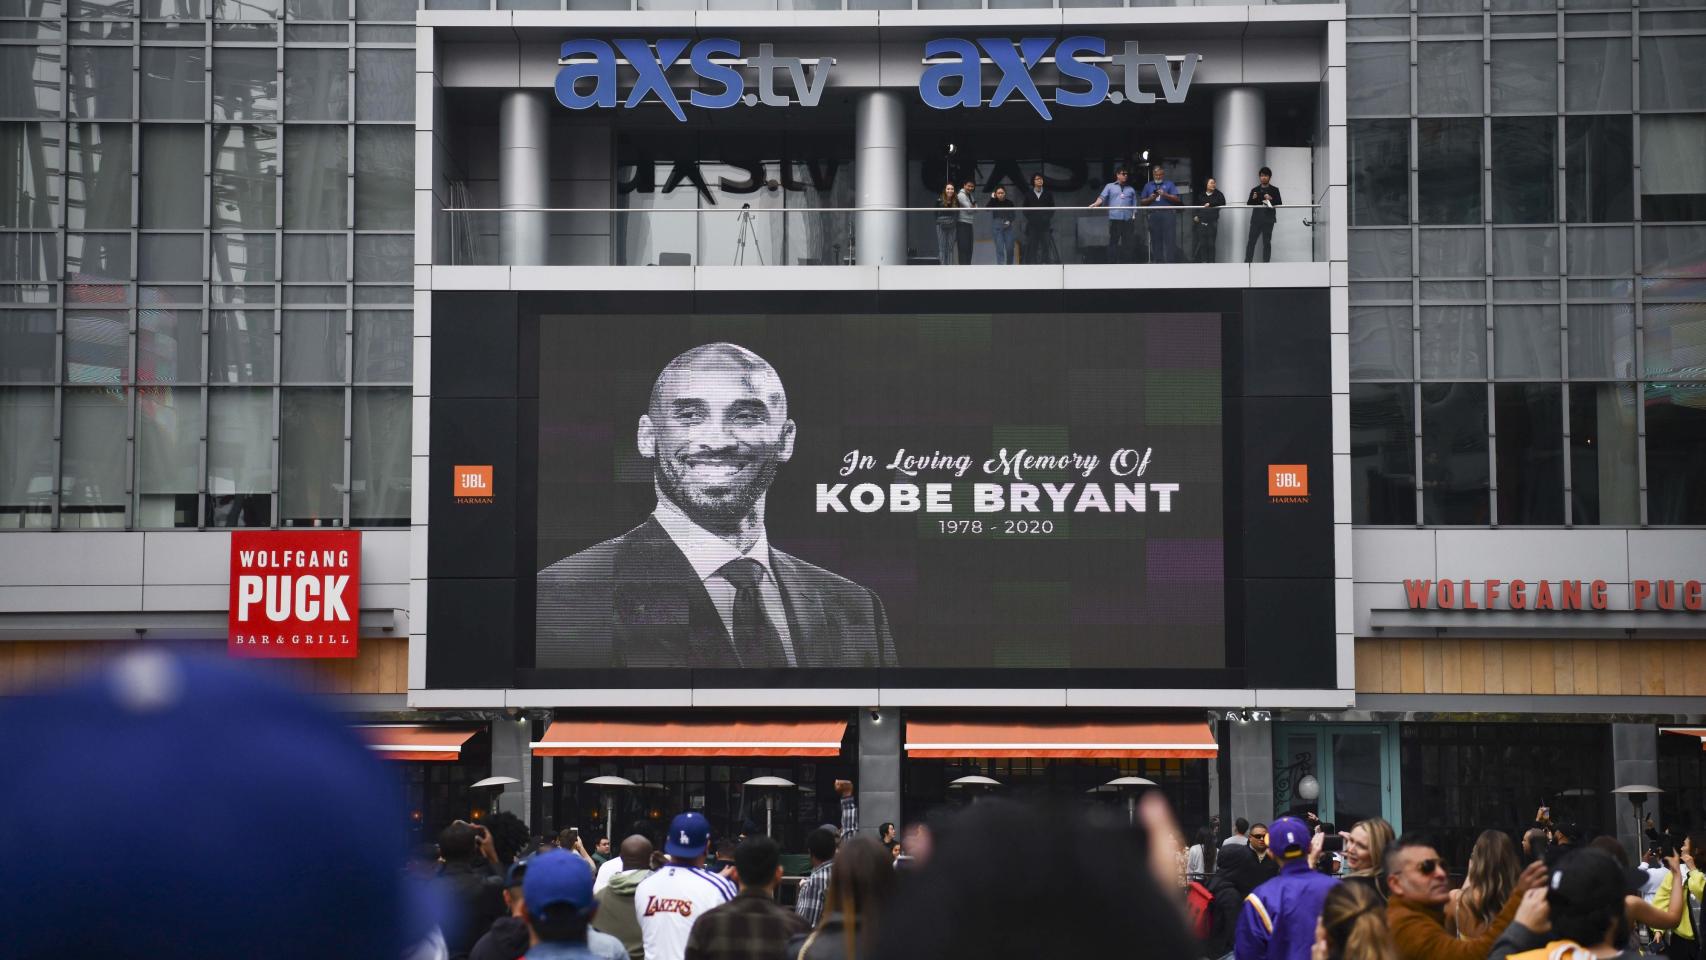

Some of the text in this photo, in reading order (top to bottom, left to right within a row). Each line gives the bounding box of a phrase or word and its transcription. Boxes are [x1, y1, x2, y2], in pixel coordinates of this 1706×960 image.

[554, 38, 834, 122] axs.tv
[918, 36, 1199, 120] axs.tv
[839, 448, 1152, 480] In Loving Memory Of
[462, 473, 486, 488] JBL
[1276, 473, 1300, 488] JBL
[816, 483, 1180, 513] KOBE BRYANT
[938, 520, 983, 534] 1978
[1004, 520, 1054, 534] 2020
[240, 550, 348, 568] WOLFGANG
[238, 574, 351, 622] PUCK
[1403, 578, 1608, 610] WOLFGANG
[236, 635, 349, 644] BAR & GRILL
[643, 895, 692, 917] LAKERS
